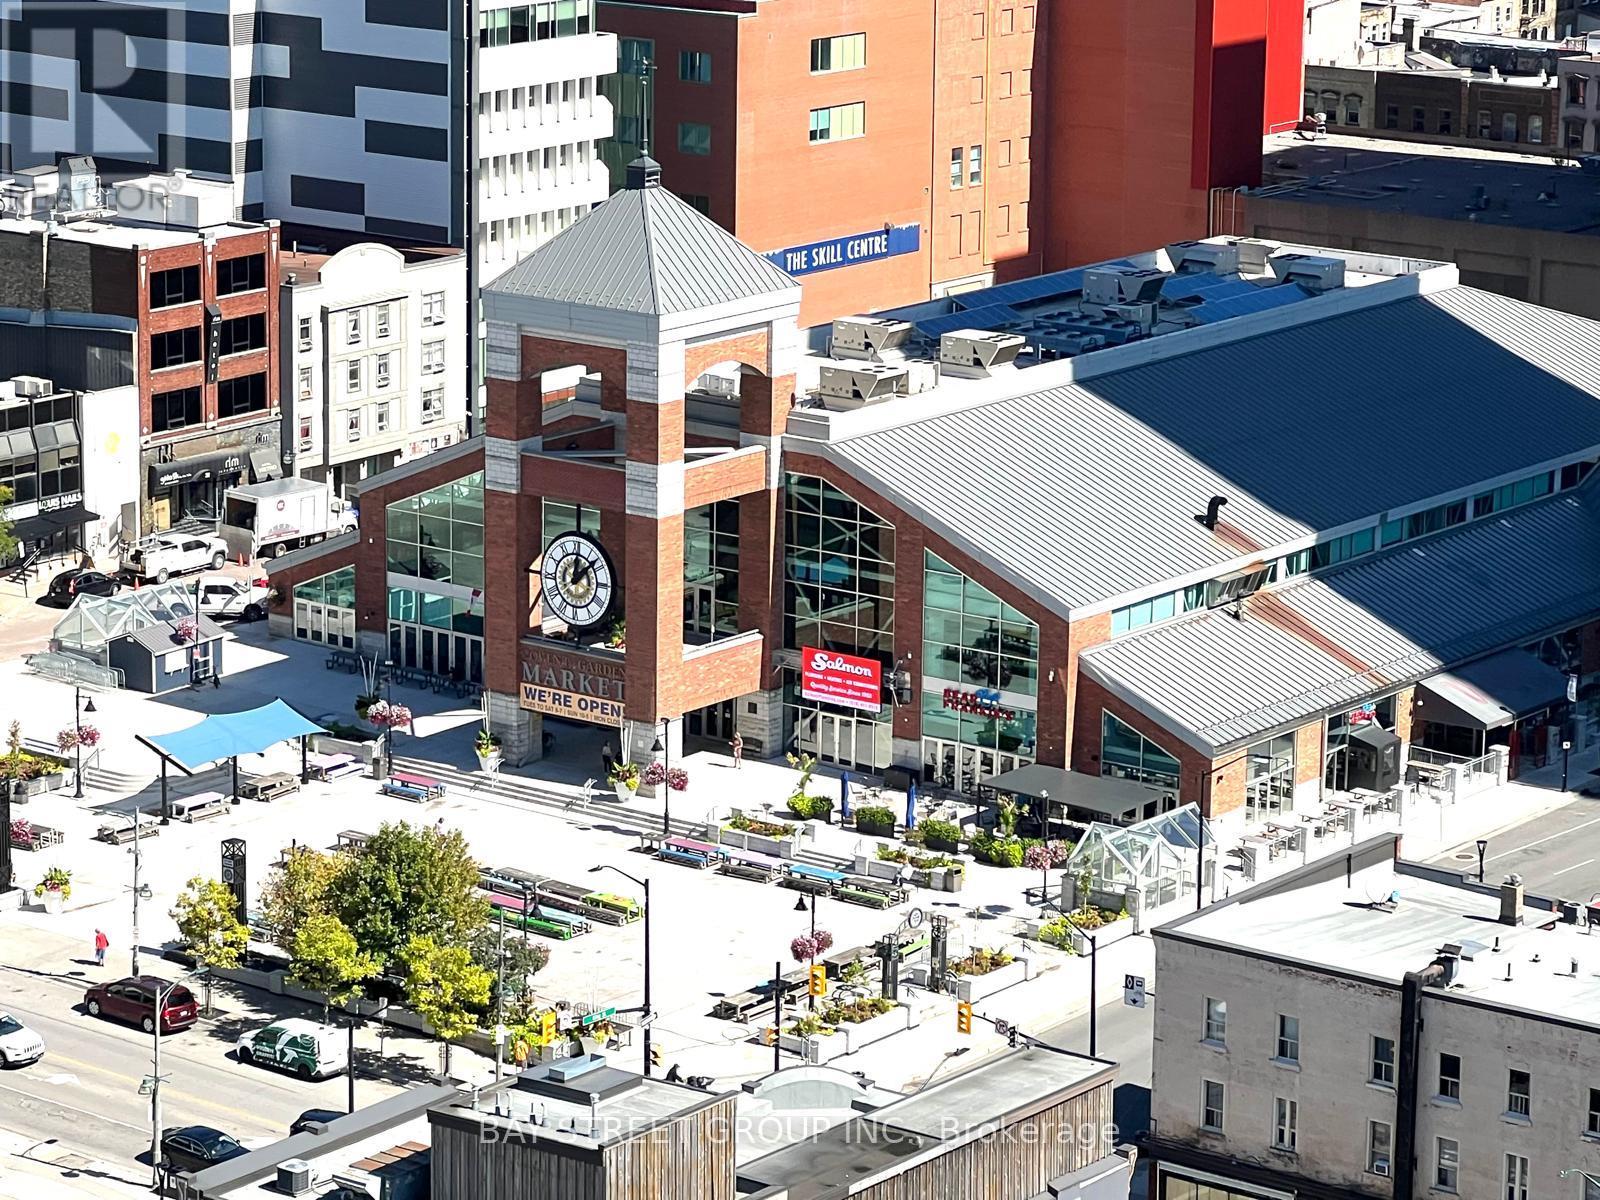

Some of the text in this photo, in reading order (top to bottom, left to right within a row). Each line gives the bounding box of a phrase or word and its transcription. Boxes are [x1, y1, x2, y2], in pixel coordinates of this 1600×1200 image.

[786, 234, 888, 272] THE SKILL CENTRE
[61, 492, 83, 504] NAILS
[521, 660, 625, 700] MARKET
[810, 652, 873, 677] Salmon
[523, 686, 621, 718] WE'RE OPEN
